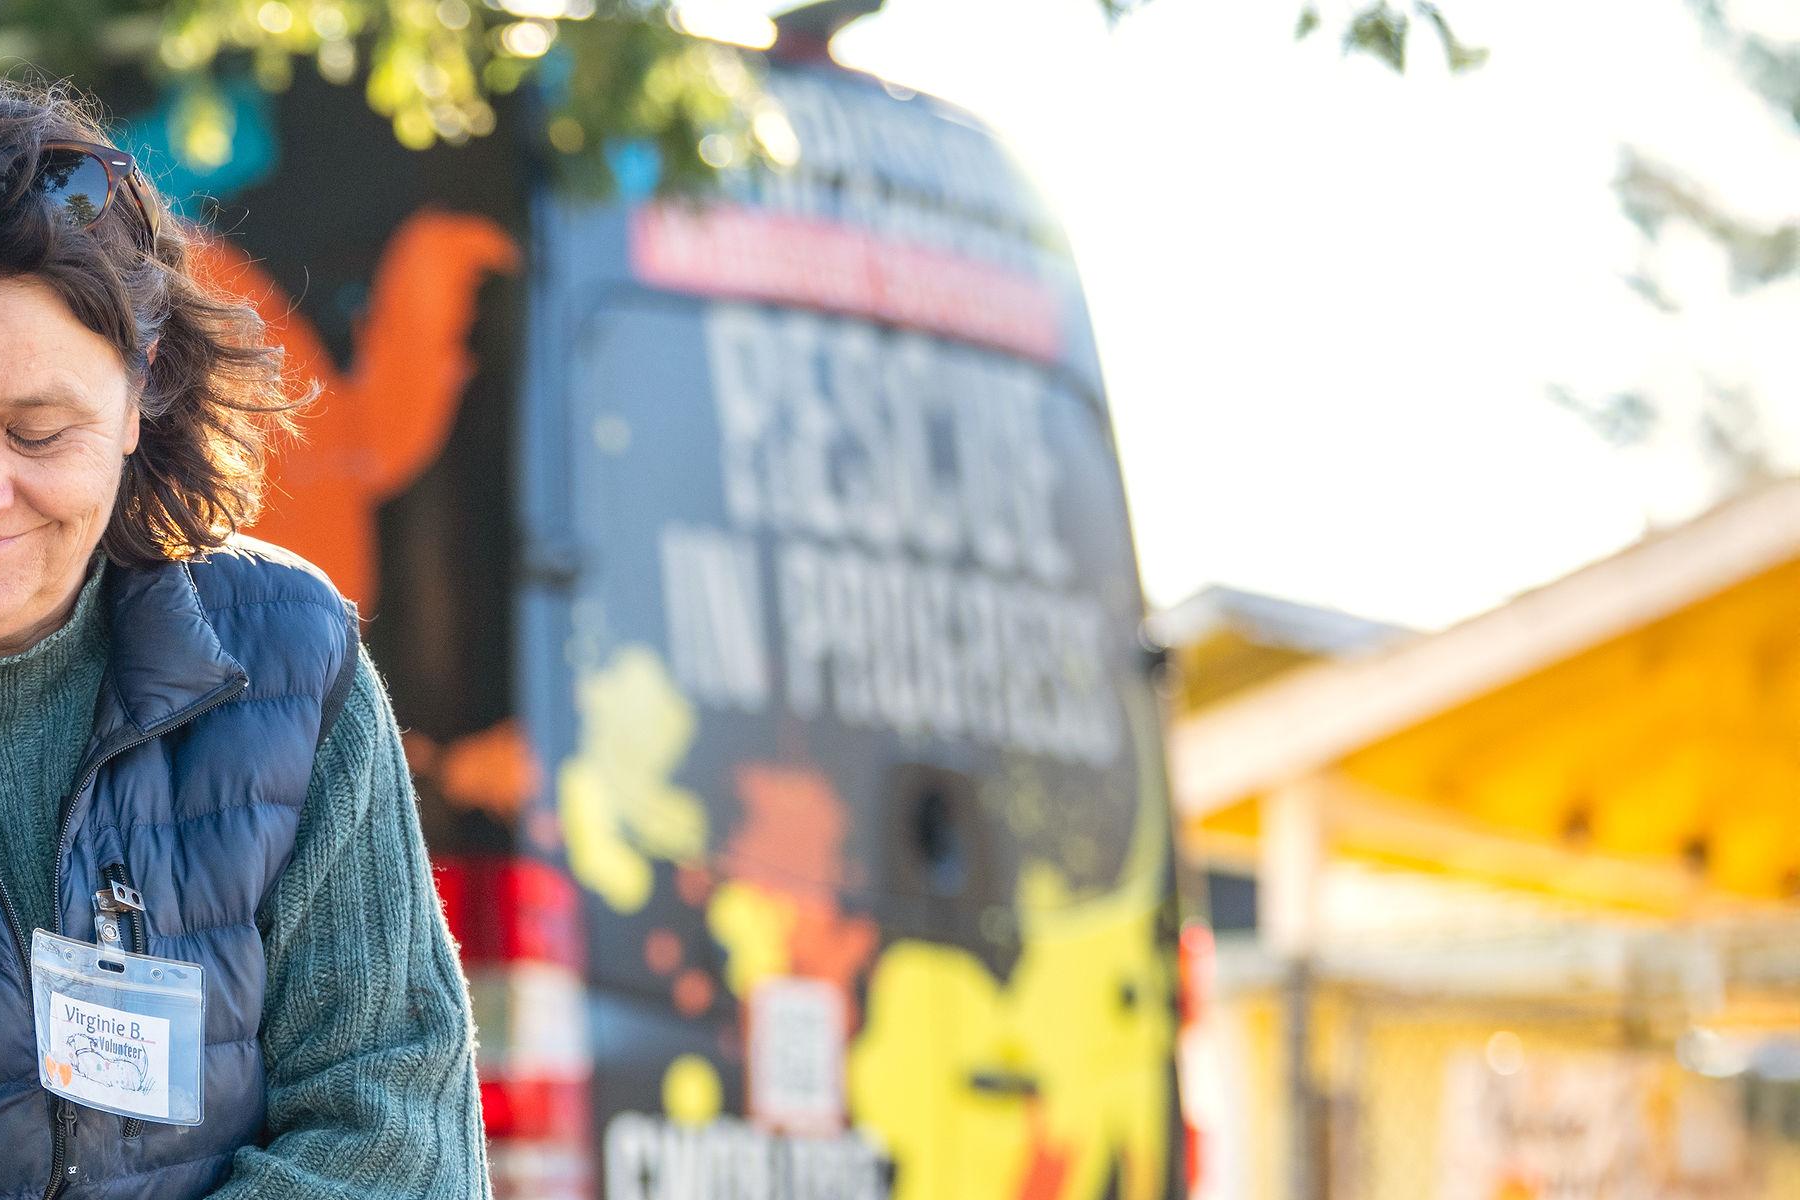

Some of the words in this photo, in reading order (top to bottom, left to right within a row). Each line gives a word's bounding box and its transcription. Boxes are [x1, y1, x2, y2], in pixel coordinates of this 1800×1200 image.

[65, 1004, 125, 1036] Virginie
[130, 1022, 144, 1040] B.
[99, 1036, 143, 1059] Volunteer
